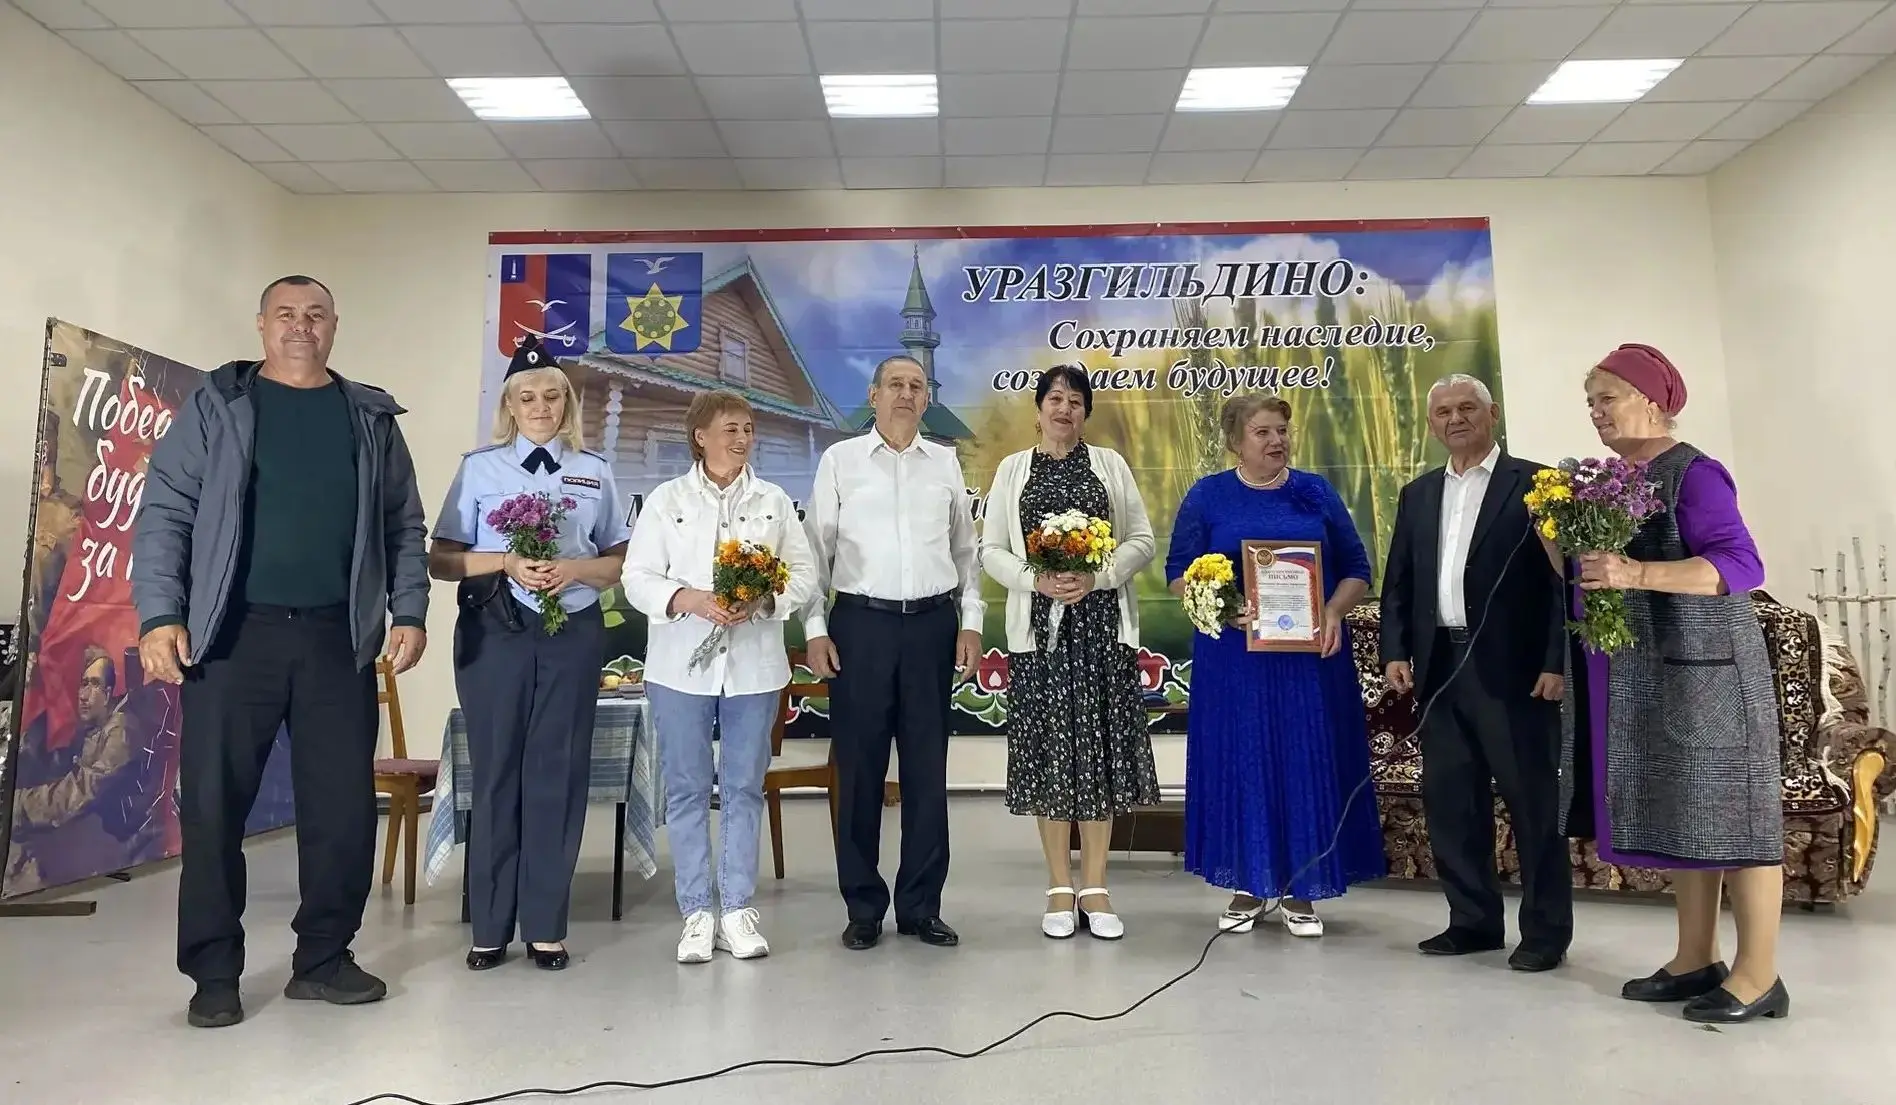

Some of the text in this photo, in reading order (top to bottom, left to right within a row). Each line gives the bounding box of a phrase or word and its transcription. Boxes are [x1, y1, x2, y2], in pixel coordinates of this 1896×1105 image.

[962, 261, 1369, 305] УРАЗГИЛЬДИНО:
[1048, 318, 1436, 357] Сохраняем наследие,
[992, 356, 1333, 397] созаем будущее!
[87, 438, 146, 531] буд
[67, 538, 118, 601] за
